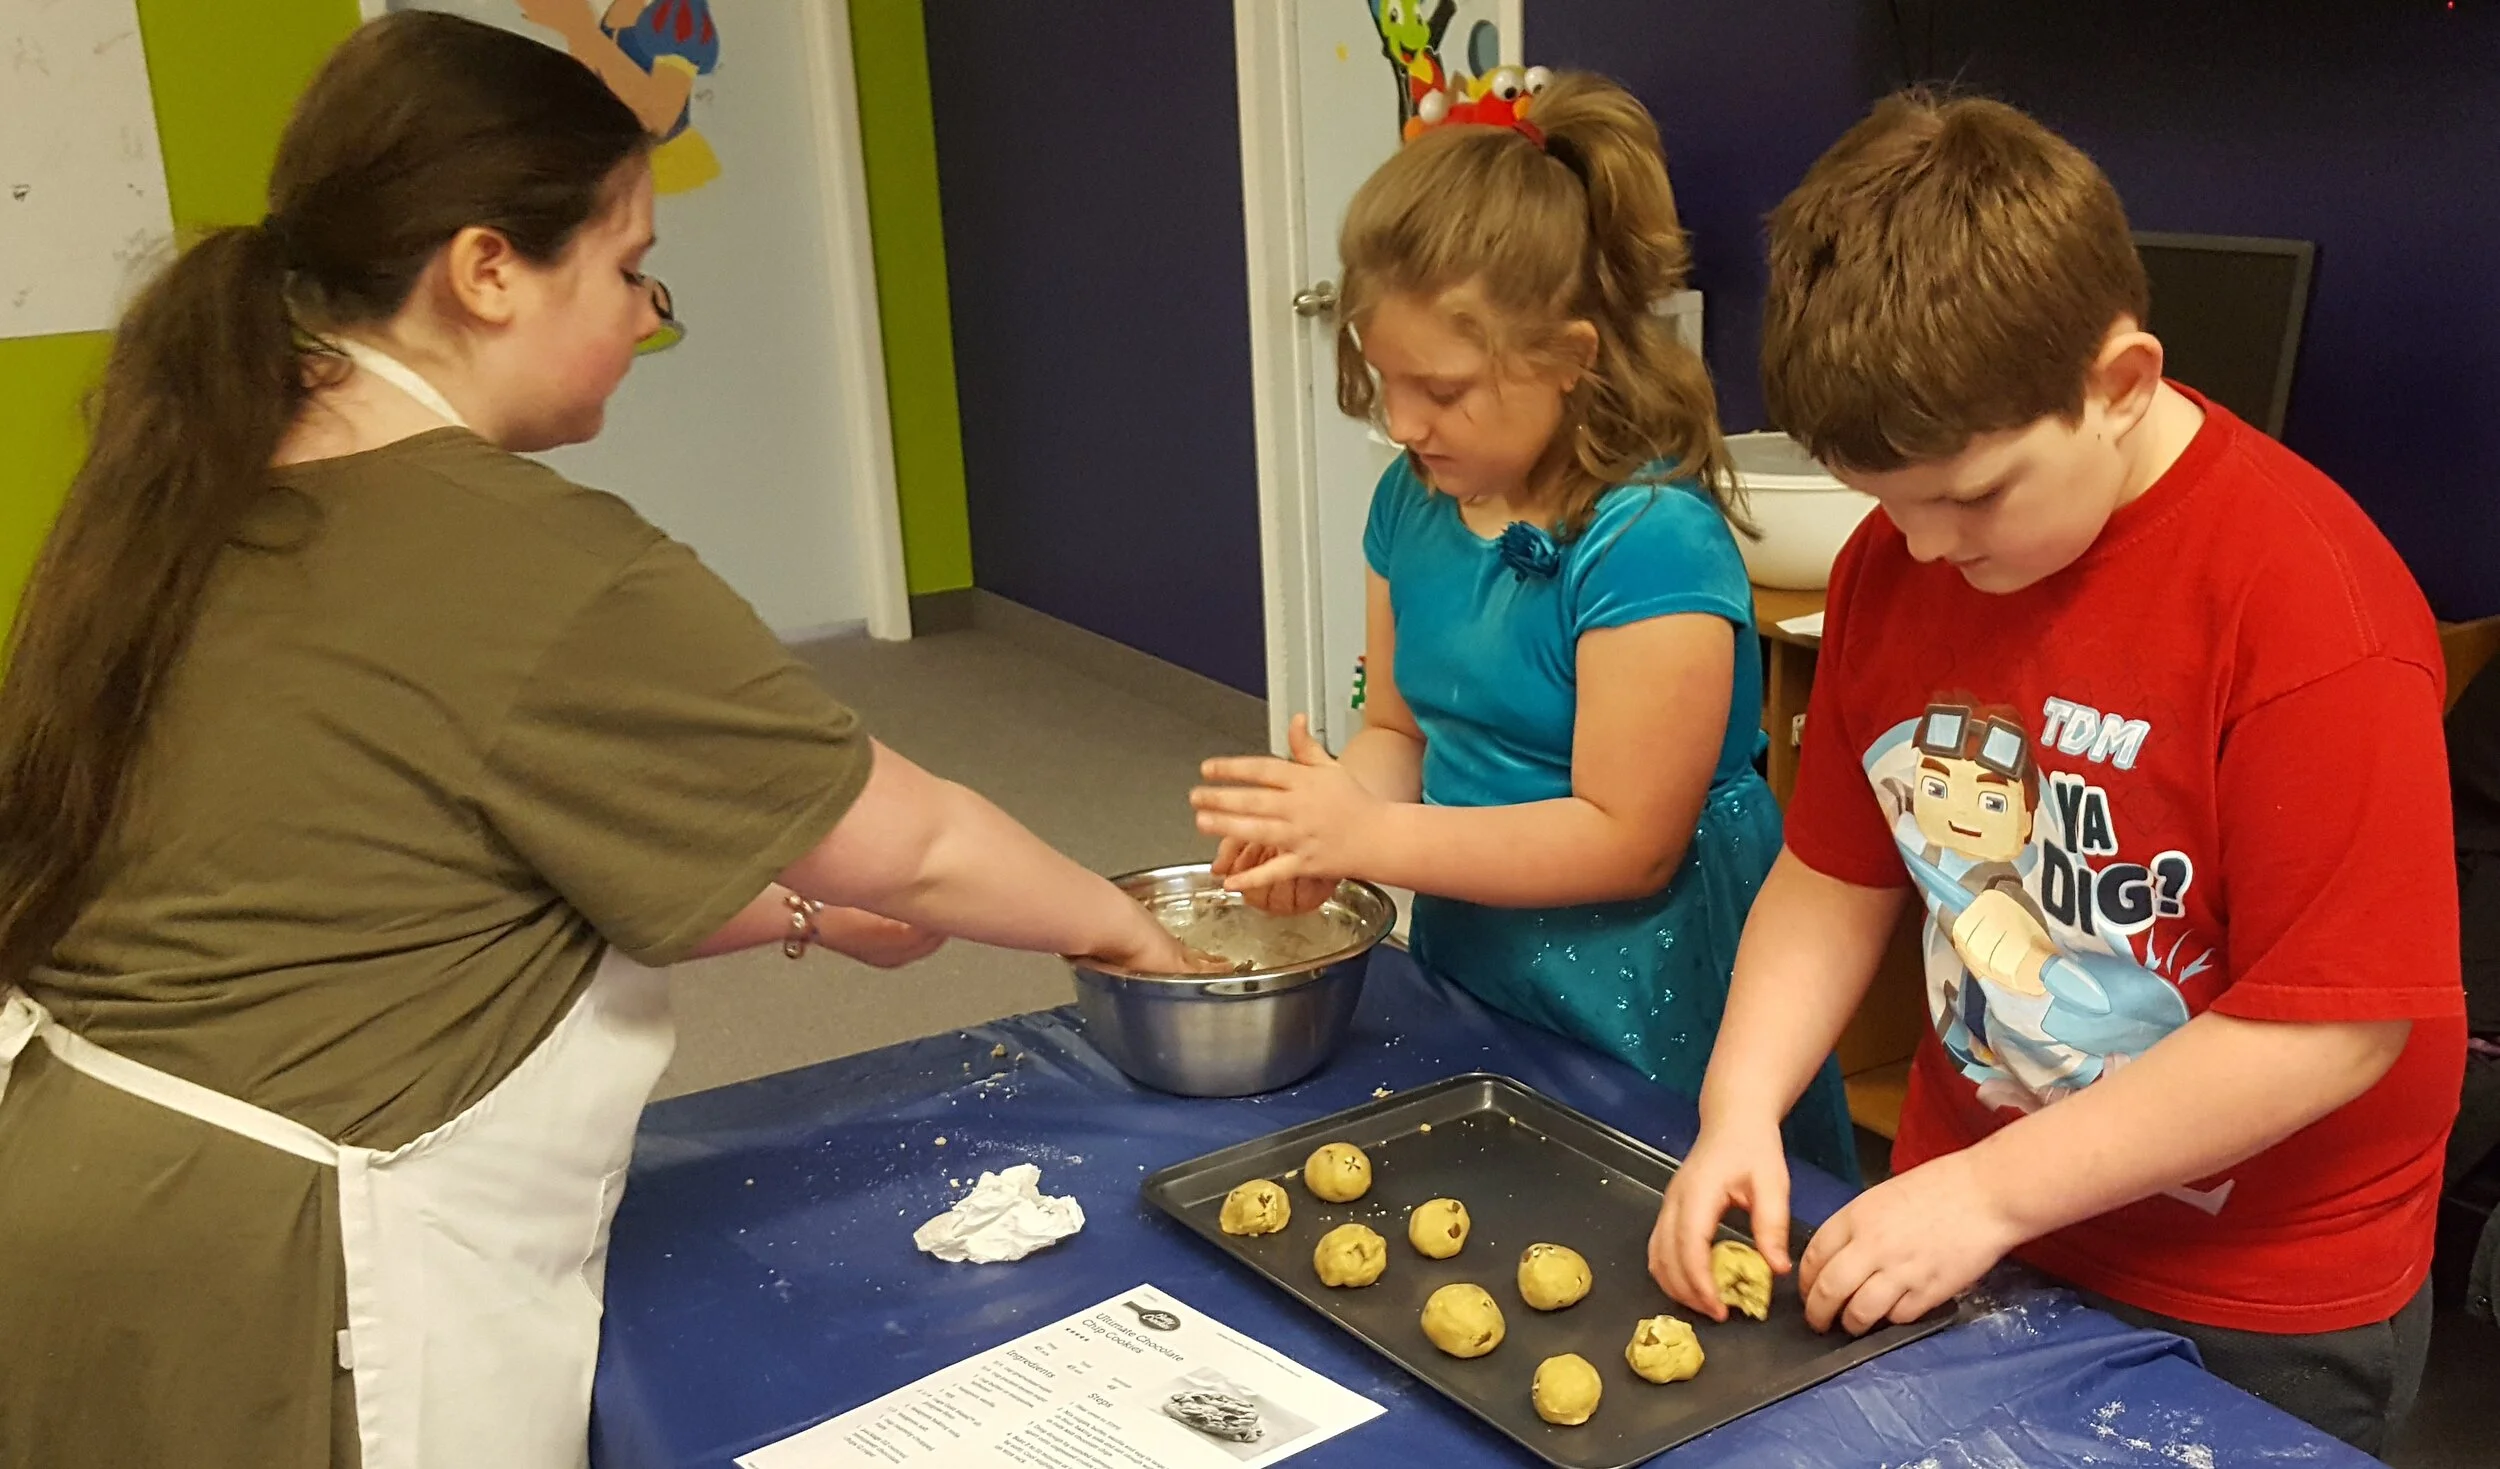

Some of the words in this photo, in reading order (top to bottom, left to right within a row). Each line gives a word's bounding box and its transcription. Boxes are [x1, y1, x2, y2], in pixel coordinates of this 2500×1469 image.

[2041, 696, 2151, 771] TDM
[2050, 771, 2119, 857] YA
[2040, 838, 2194, 937] DIG?
[1082, 1319, 1105, 1333] Chip
[1105, 1332, 1143, 1353] Cookies
[1096, 1313, 1136, 1337] Ultimate
[1136, 1335, 1184, 1361] Chocolate
[1006, 1350, 1055, 1378] Ingredients
[1088, 1393, 1113, 1408] Steps
